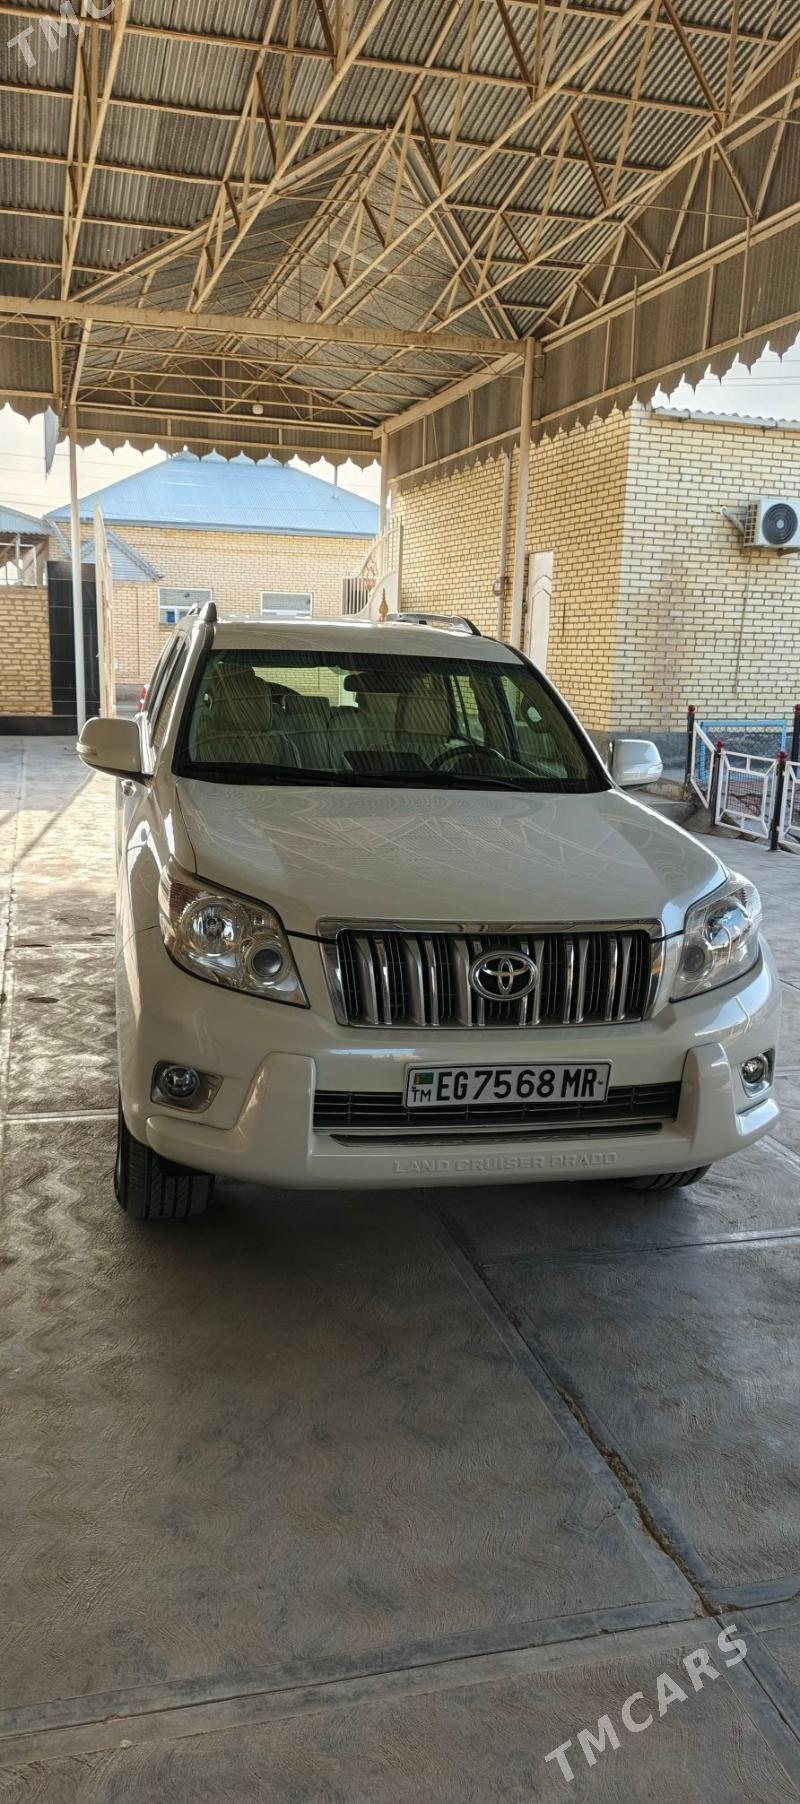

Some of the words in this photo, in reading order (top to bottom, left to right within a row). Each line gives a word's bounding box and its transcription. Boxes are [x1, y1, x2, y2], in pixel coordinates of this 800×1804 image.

[412, 1088, 431, 1102] TM
[394, 1158, 449, 1174] LAND
[456, 1155, 545, 1172] CRUISER
[551, 1152, 617, 1168] PRADO
